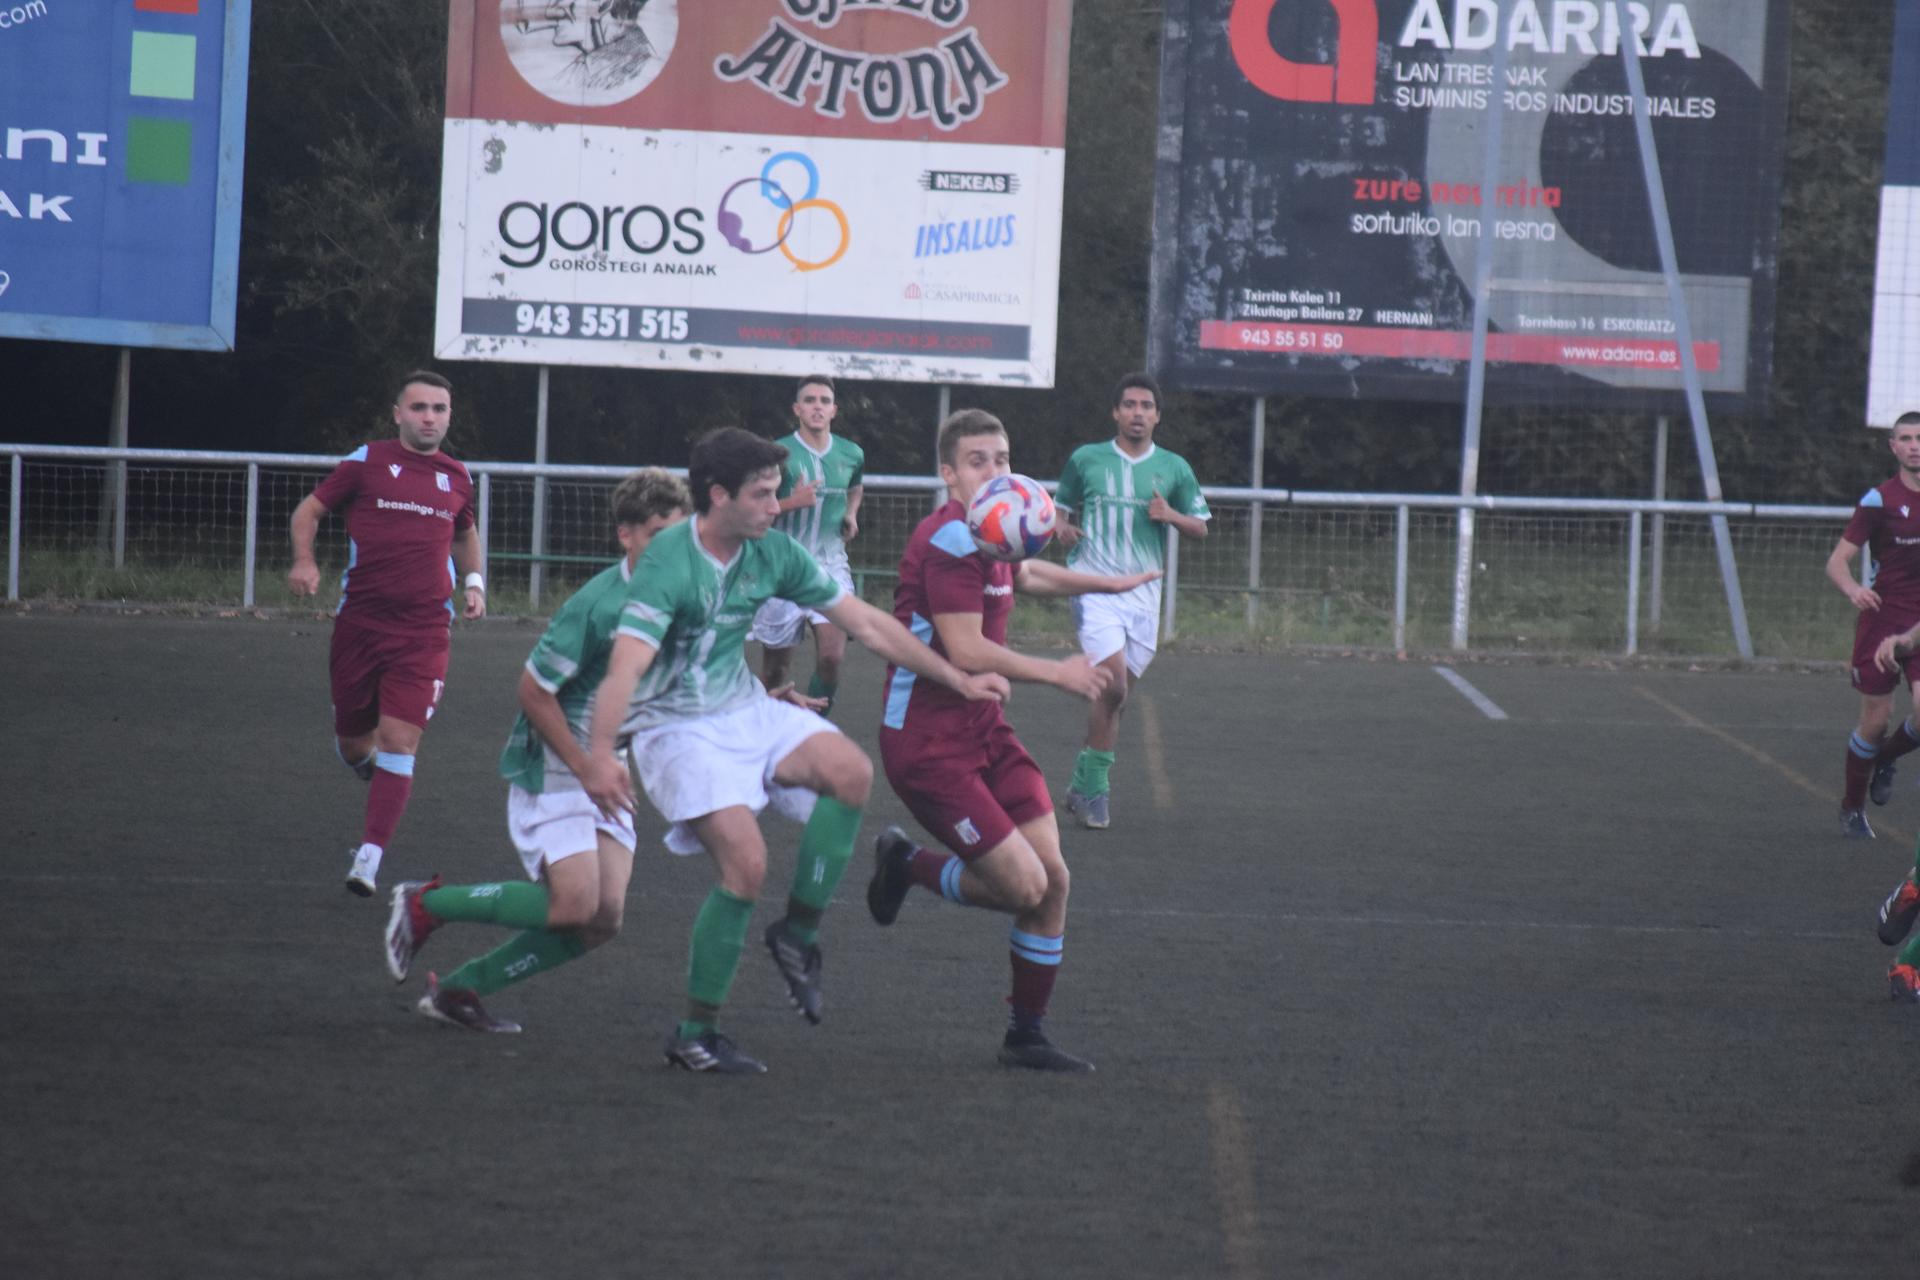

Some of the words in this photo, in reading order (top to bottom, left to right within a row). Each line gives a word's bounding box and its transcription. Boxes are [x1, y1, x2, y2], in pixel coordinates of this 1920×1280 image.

[1400, 0, 1701, 58] ADARRA
[719, 22, 1002, 126] AITONA
[1396, 62, 1440, 83] LAN
[936, 173, 1006, 192] NEKEAS
[1354, 178, 1422, 202] zure
[499, 201, 705, 268] goros
[1448, 213, 1481, 237] lan
[915, 213, 1016, 259] INSALUS
[550, 258, 646, 274] GOROSTEGI
[653, 263, 717, 276] ANAIAK
[1244, 289, 1287, 302] Txirrita
[1291, 291, 1324, 304] Kalea
[1328, 292, 1341, 304] 11
[516, 304, 570, 335] 943
[580, 307, 630, 338] 551
[640, 309, 689, 341] 515
[1302, 306, 1345, 321] Bailara
[1349, 309, 1363, 322] 27
[1376, 310, 1433, 325] HERNANI
[1581, 316, 1596, 330] 16
[1242, 329, 1271, 345] 943
[1275, 332, 1295, 346] 55
[1299, 332, 1317, 347] 51
[1323, 334, 1343, 349] 50
[1563, 346, 1677, 363] www.adarra.es
